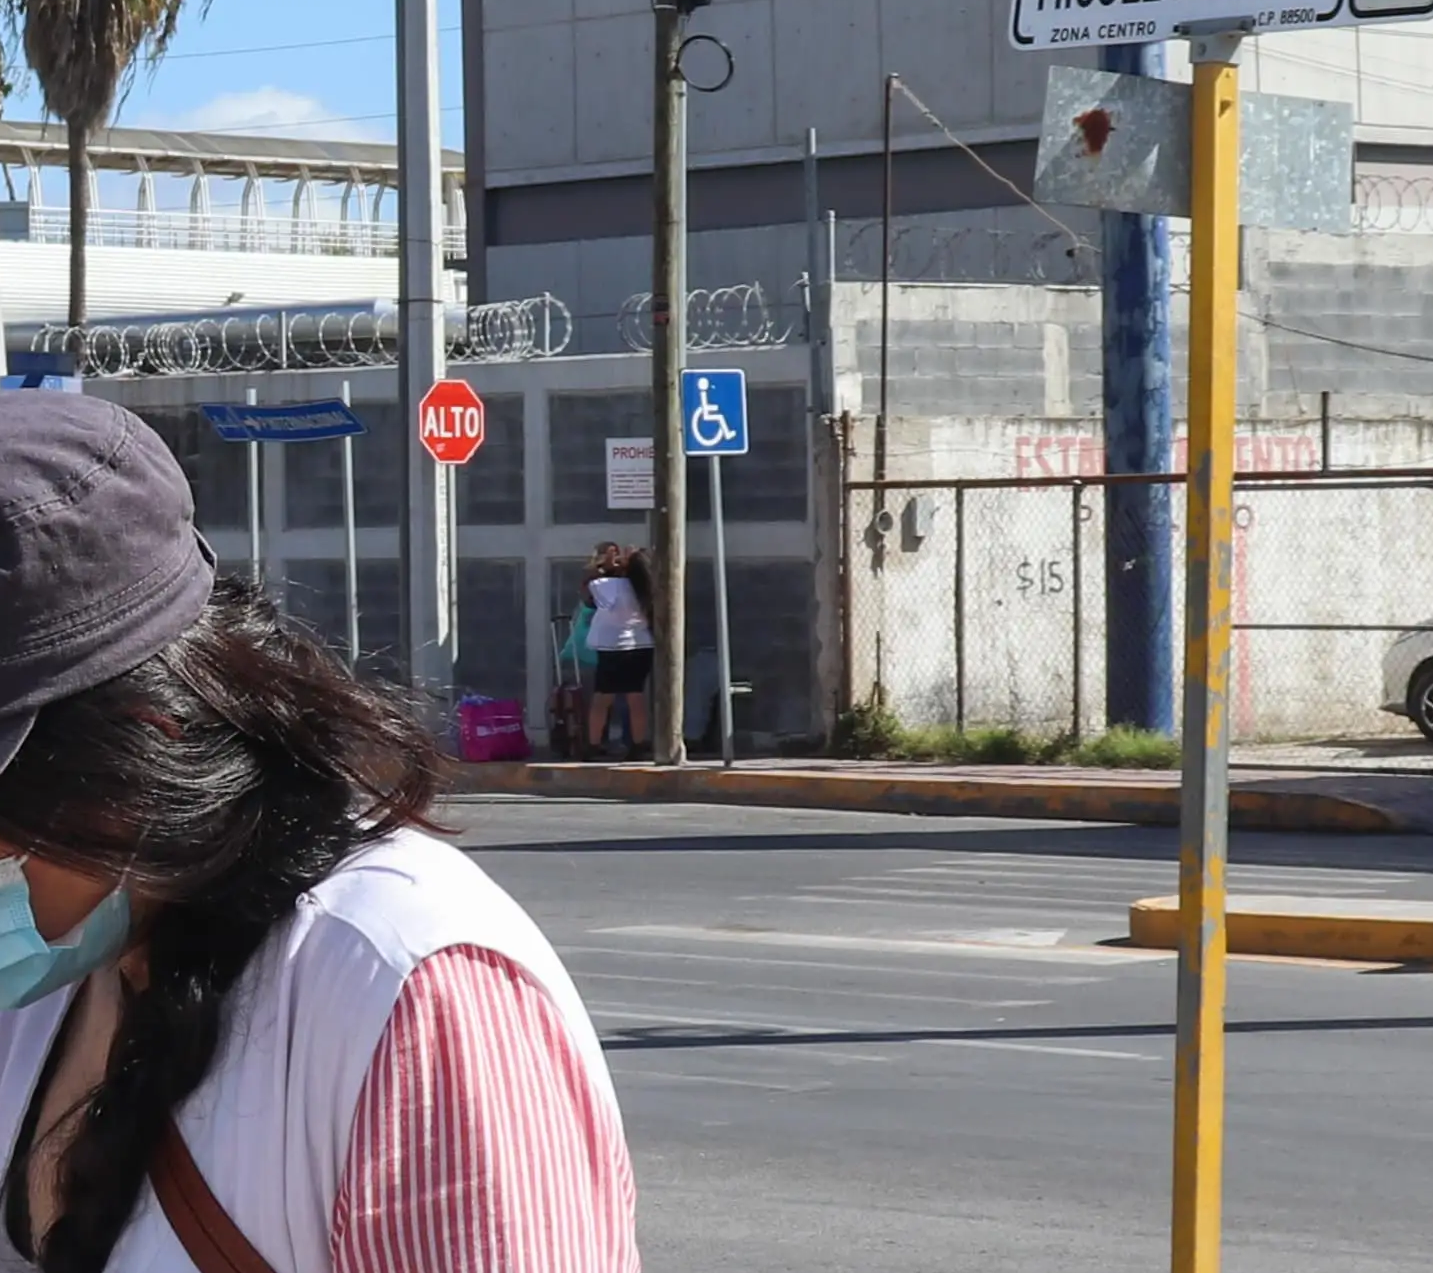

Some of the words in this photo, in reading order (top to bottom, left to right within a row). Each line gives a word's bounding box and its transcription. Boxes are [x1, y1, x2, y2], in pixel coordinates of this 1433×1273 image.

[1050, 24, 1090, 43] ZONA
[1098, 21, 1156, 39] CENTRO
[1279, 8, 1316, 24] 88500
[423, 406, 480, 438] ALTO
[1016, 556, 1065, 599] $15
